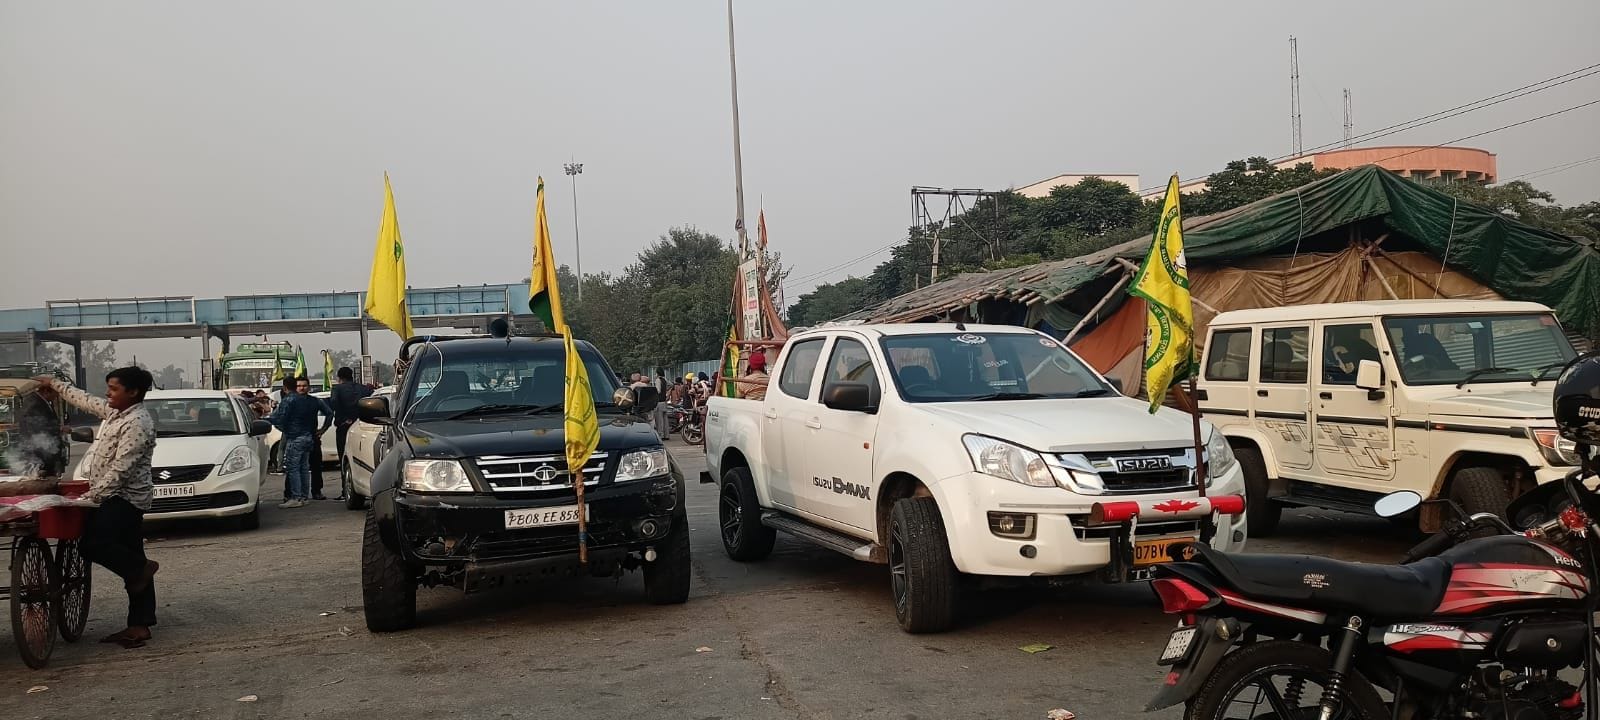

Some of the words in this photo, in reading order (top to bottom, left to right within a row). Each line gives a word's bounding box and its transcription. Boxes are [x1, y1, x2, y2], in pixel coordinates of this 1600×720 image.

[1118, 459, 1169, 472] ISUZU
[153, 486, 193, 497] 01BV0164
[812, 475, 832, 490] ISUZU
[832, 476, 872, 501] D-MAX
[508, 513, 540, 526] PB08
[543, 511, 558, 523] EE
[560, 509, 580, 522] 858
[1554, 555, 1582, 569] Hero
